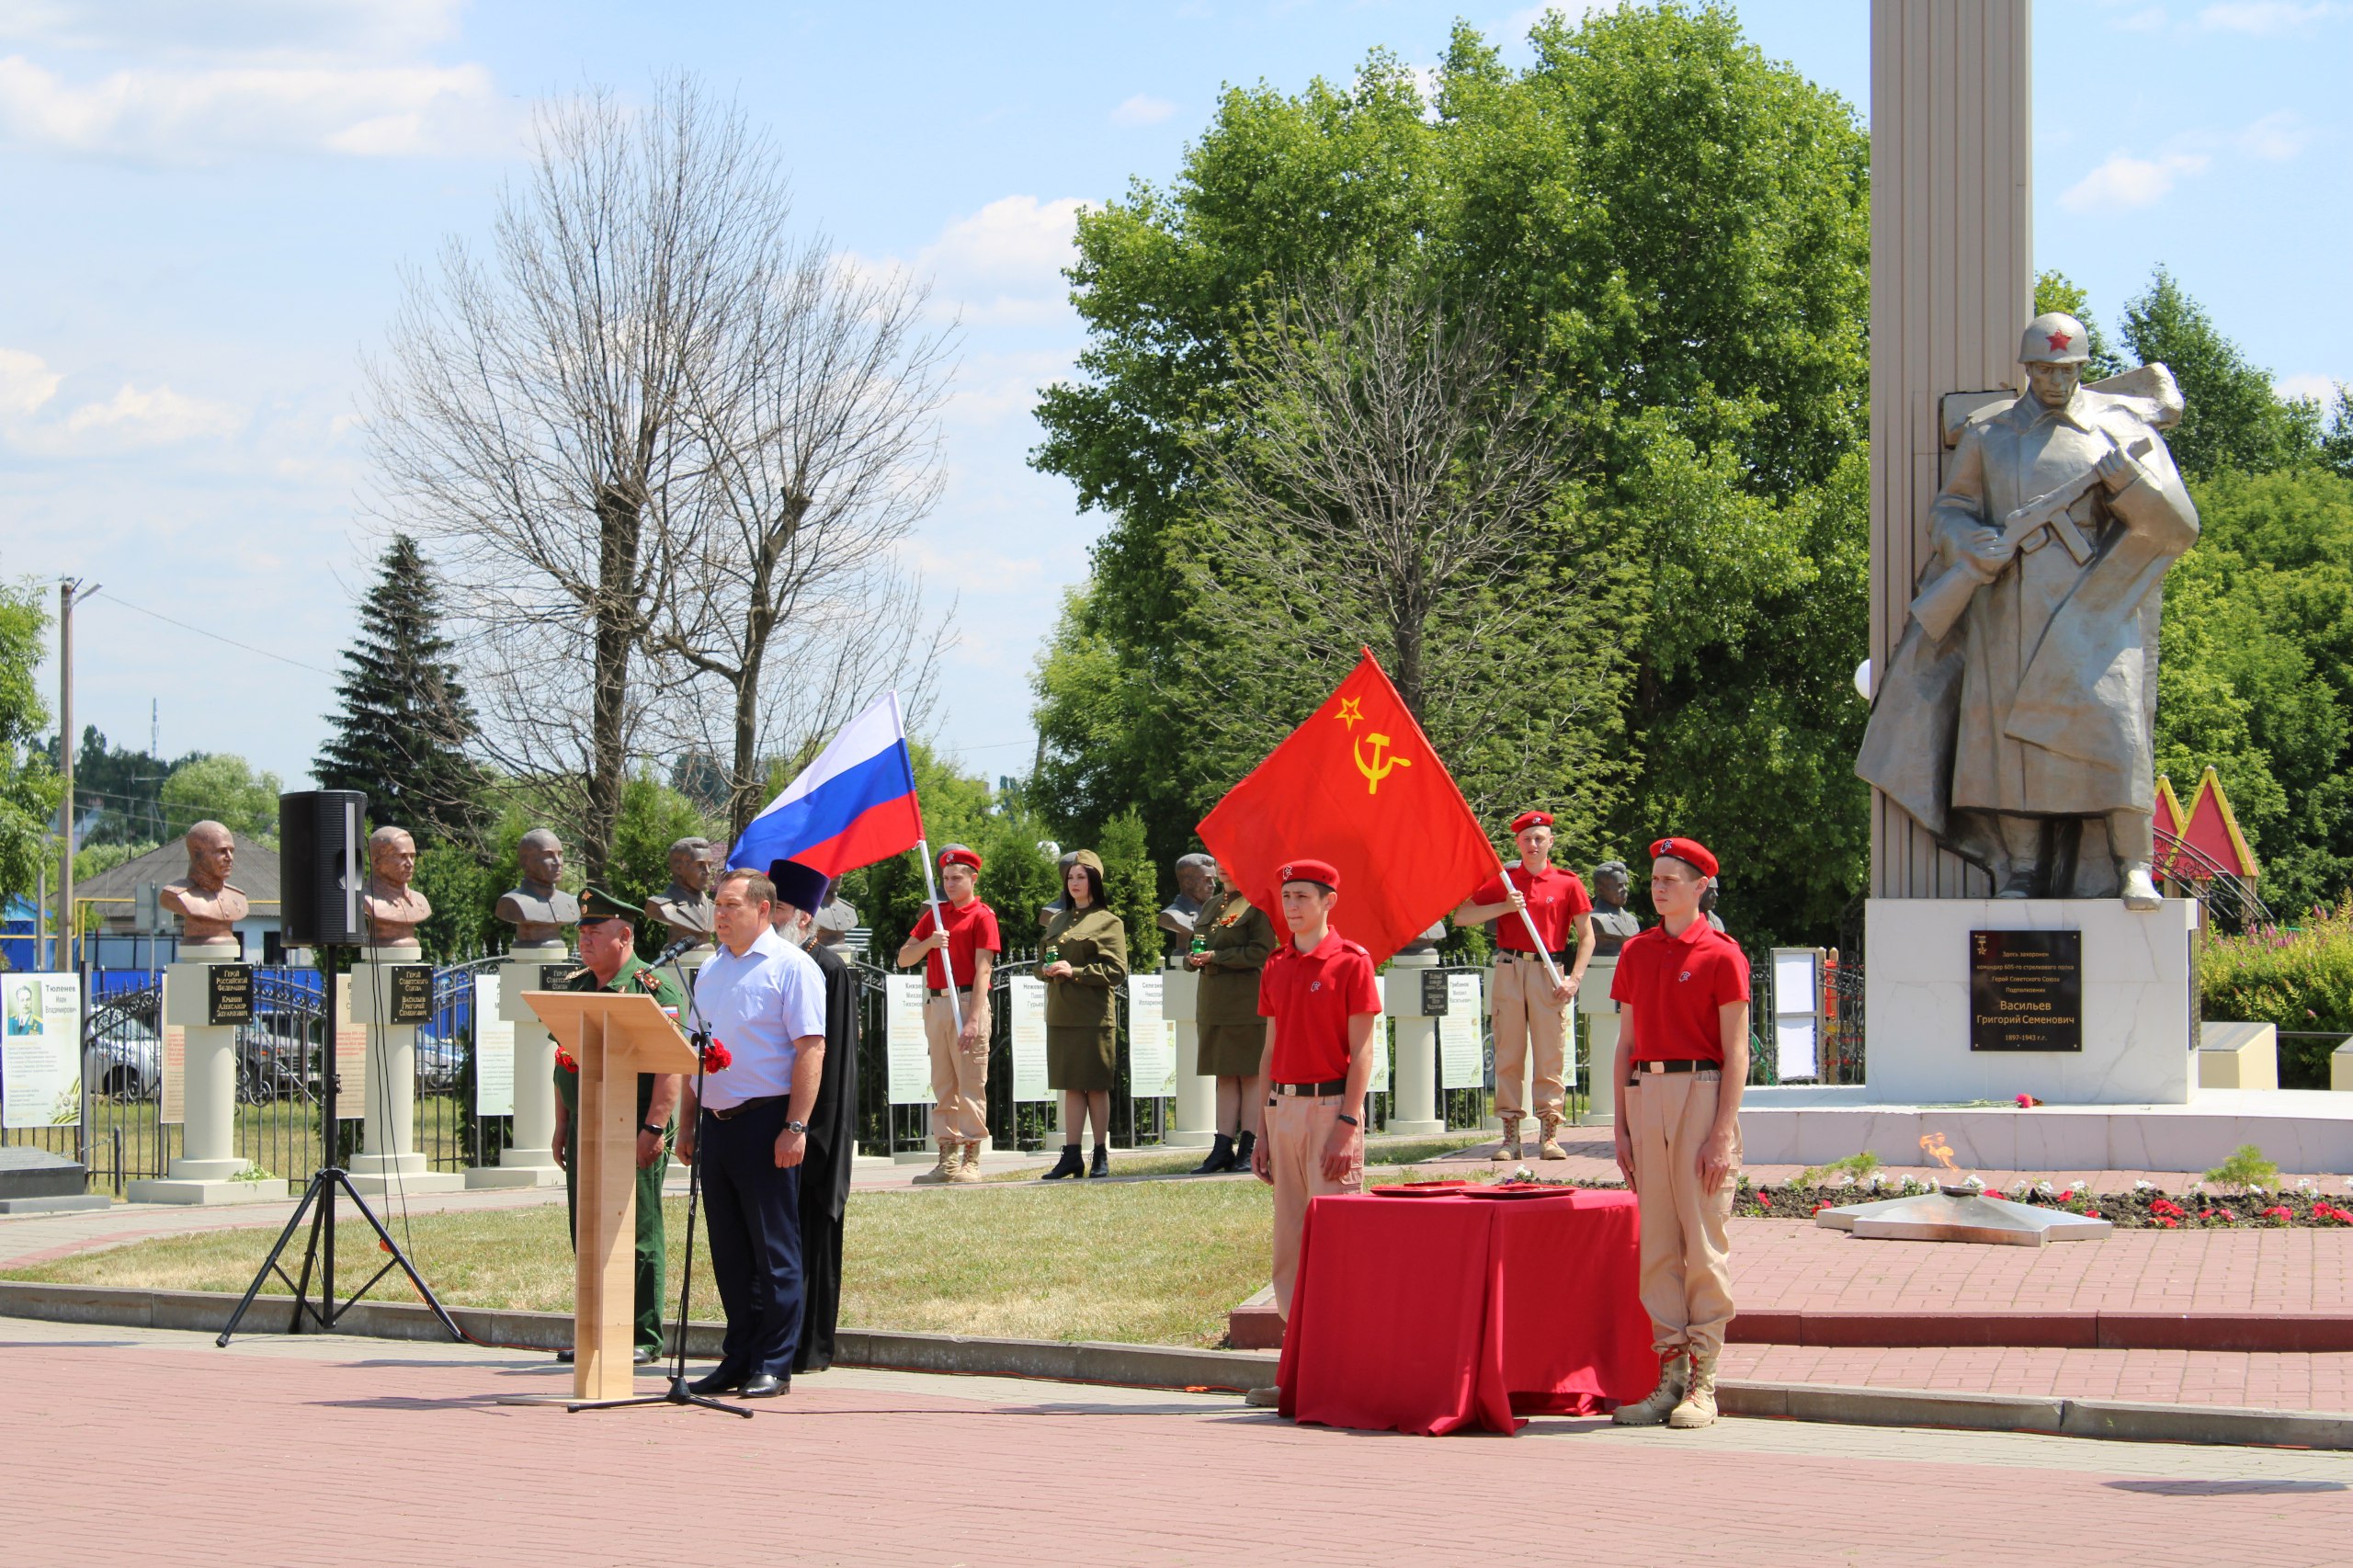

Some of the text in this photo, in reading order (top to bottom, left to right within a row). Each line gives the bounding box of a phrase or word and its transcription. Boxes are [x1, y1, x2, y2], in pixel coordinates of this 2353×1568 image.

[45, 984, 76, 993] Тюленев
[55, 995, 67, 1004] Иван
[1027, 1000, 1044, 1008] Гурьев
[2000, 1000, 2052, 1011] Васильев
[45, 1006, 77, 1015] Владимирович
[1976, 1014, 2075, 1025] Григорий Семенович
